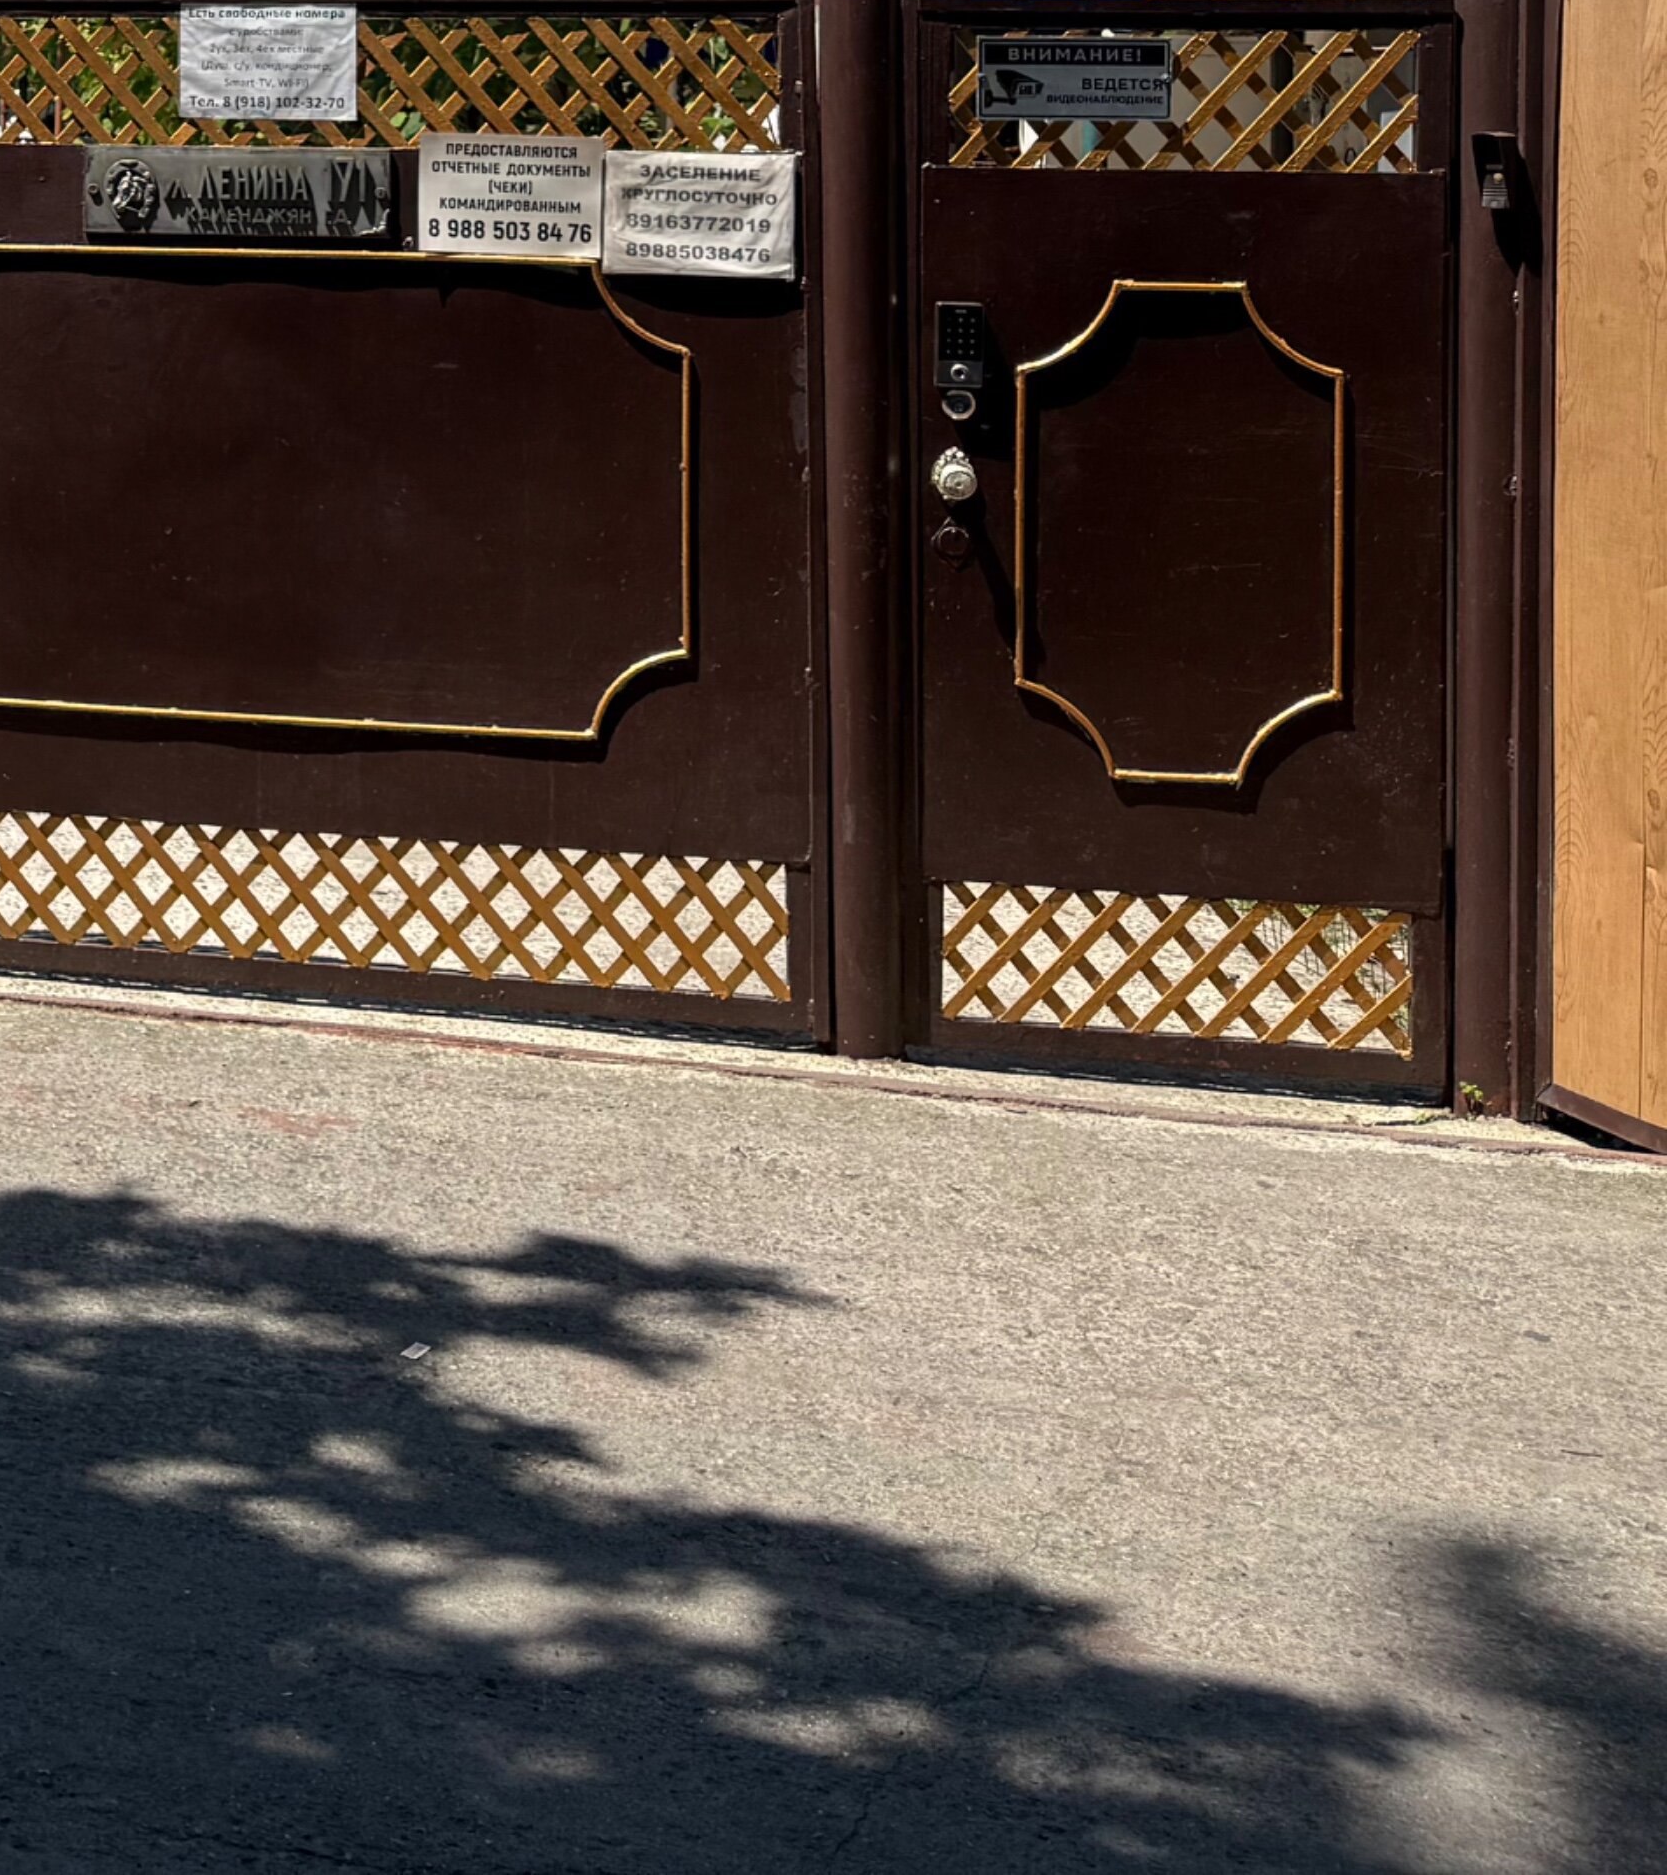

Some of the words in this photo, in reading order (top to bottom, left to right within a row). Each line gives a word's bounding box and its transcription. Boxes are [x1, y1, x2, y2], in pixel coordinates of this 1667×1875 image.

[188, 9, 215, 19] Есть
[218, 8, 292, 20] свободные
[295, 10, 346, 20] номера
[1007, 47, 1142, 63] ВНИМАНИЕ!
[1081, 78, 1164, 92] ВЕДЕТСЯ
[190, 95, 219, 108] Тел.
[222, 96, 231, 109] 8
[235, 95, 271, 111] (918)
[276, 96, 345, 109] 102-32-70
[1046, 94, 1164, 105] ВИДЕОНАБЛЮДЕНИЕ
[446, 142, 578, 158] ПРЕДОСТАВЛЯЮТСЯ
[431, 160, 501, 175] ОТЧЕТНЫЕ
[505, 163, 591, 178] ДОКУМЕНТЫ
[640, 164, 762, 182] ЗАСЕЛЕНИЕ
[197, 163, 309, 200] ЛЕНИНА
[331, 155, 367, 203] 91
[439, 196, 581, 214] КОМАНДИРОВАННЫМ
[621, 187, 777, 206] КРУГЛОСУТОЧНО
[429, 217, 440, 237] 8
[447, 218, 485, 239] 988
[493, 220, 530, 241] 503
[537, 222, 563, 243] 84
[568, 223, 592, 243] 76
[626, 213, 771, 234] 89163772019
[626, 242, 771, 263] 89885038476
